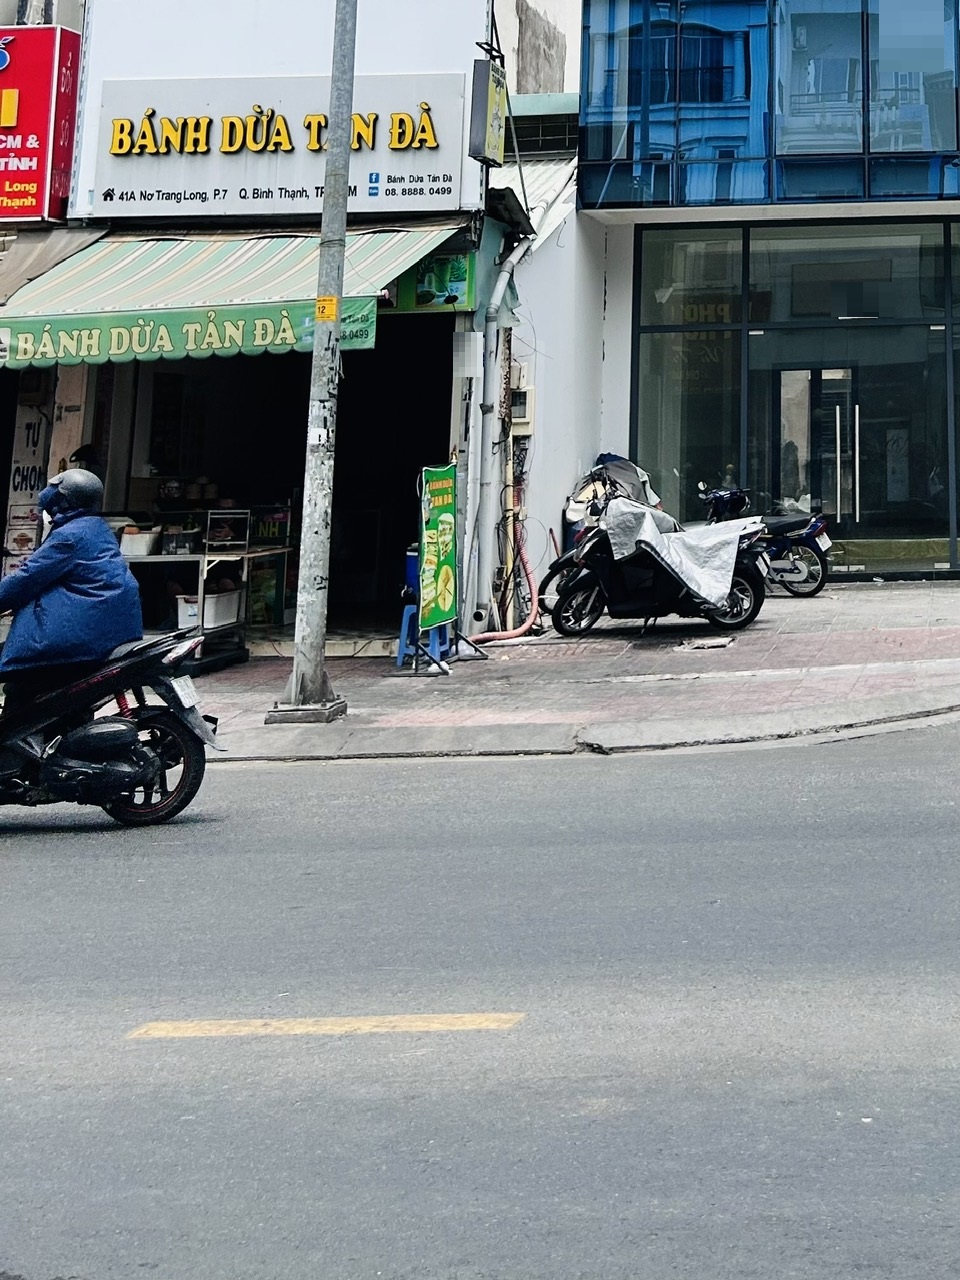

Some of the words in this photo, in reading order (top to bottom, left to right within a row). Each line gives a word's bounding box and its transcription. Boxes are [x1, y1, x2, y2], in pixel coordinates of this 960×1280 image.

[109, 107, 213, 155] BÁNH
[219, 104, 294, 152] DỪA
[303, 112, 378, 151] TN
[388, 101, 439, 150] ĐÀ
[26, 134, 40, 148] &
[5, 181, 38, 193] Long
[118, 191, 136, 202] 41A
[155, 190, 182, 203] Trang
[183, 189, 210, 203] Long,
[213, 189, 228, 200] P.7
[239, 187, 249, 199] Q.
[252, 187, 273, 199] Bình
[277, 186, 310, 200] Thạnh,
[385, 187, 398, 197] 08.
[429, 186, 452, 196] 0499
[317, 305, 326, 314] 12
[15, 323, 102, 360] BÁNH
[108, 317, 174, 355] DỪA
[181, 309, 246, 351] TẢN
[252, 309, 298, 347] ĐÀ
[25, 416, 43, 456] TỰ
